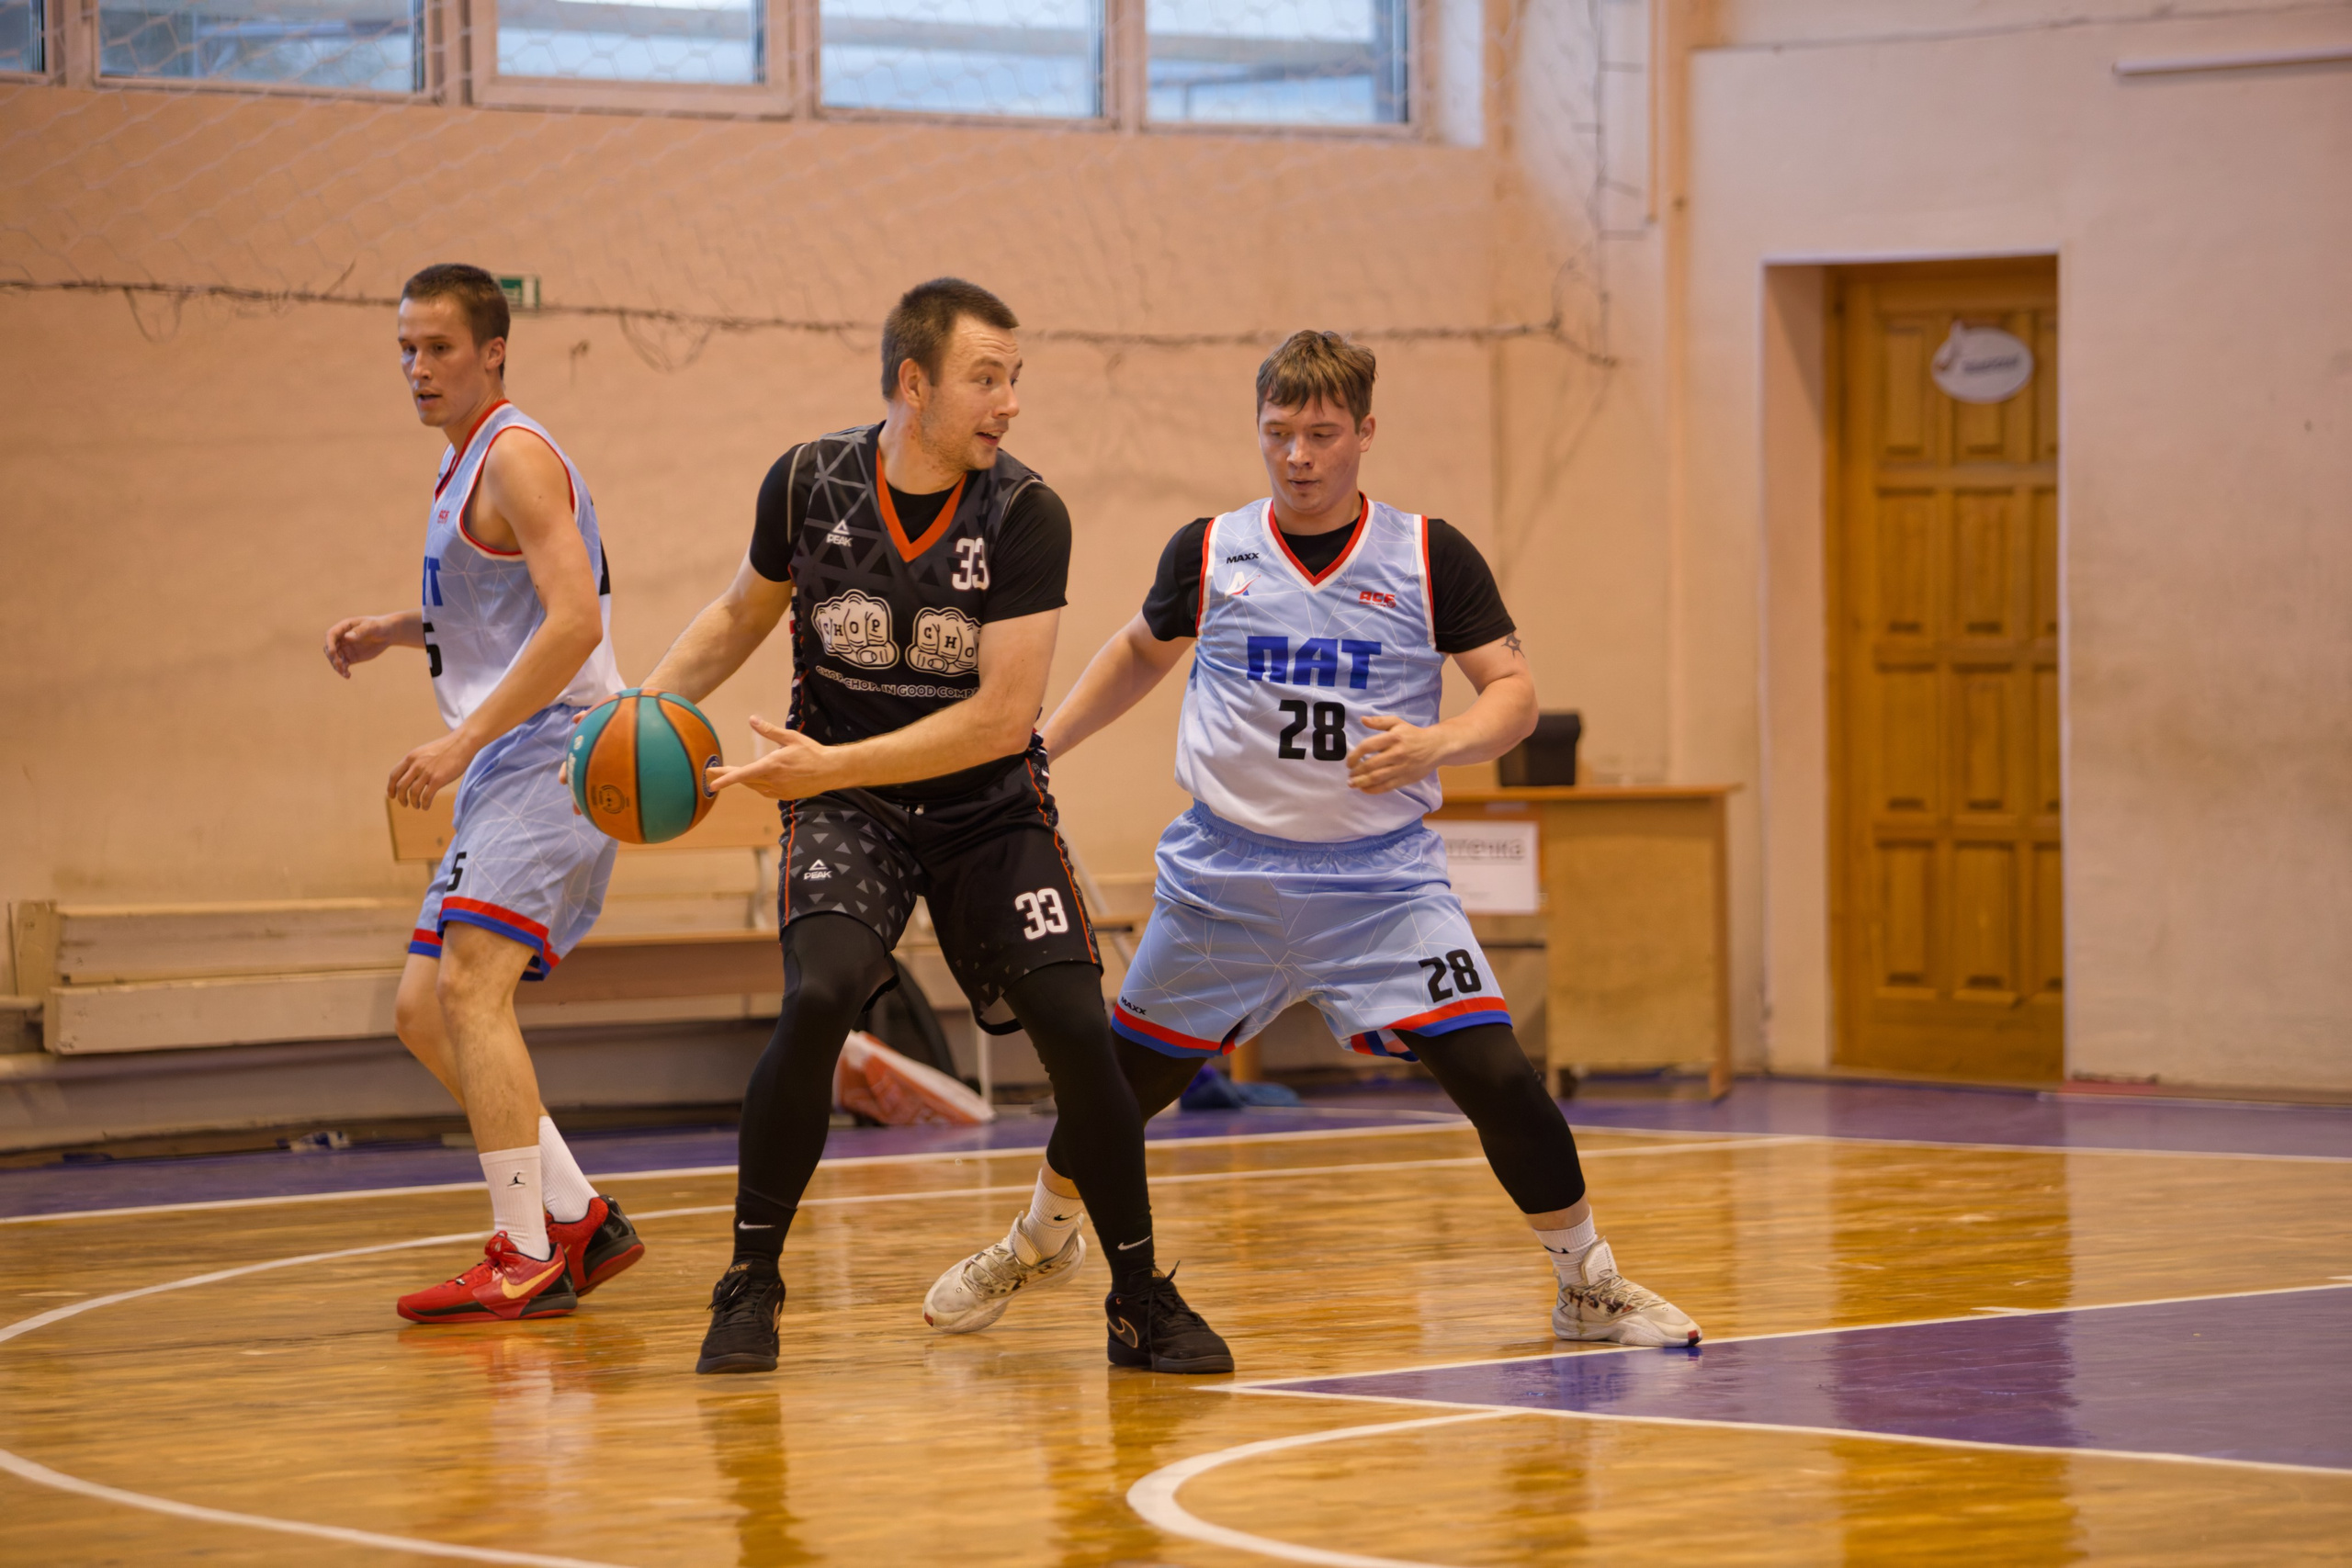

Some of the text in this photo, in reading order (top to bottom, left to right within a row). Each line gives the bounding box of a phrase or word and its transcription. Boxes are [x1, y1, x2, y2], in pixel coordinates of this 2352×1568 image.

[826, 533, 853, 547] PEAK
[1227, 552, 1260, 564] MAXX
[952, 536, 990, 591] 33
[1247, 635, 1382, 690] ПАТ
[882, 684, 897, 695] IN
[897, 684, 937, 697] GOOD
[937, 686, 980, 699] COMP
[1278, 699, 1348, 761] 28
[803, 871, 832, 881] PEAK
[1014, 887, 1069, 941] 33
[1419, 948, 1482, 1004] 28
[1121, 996, 1147, 1015] MAXX
